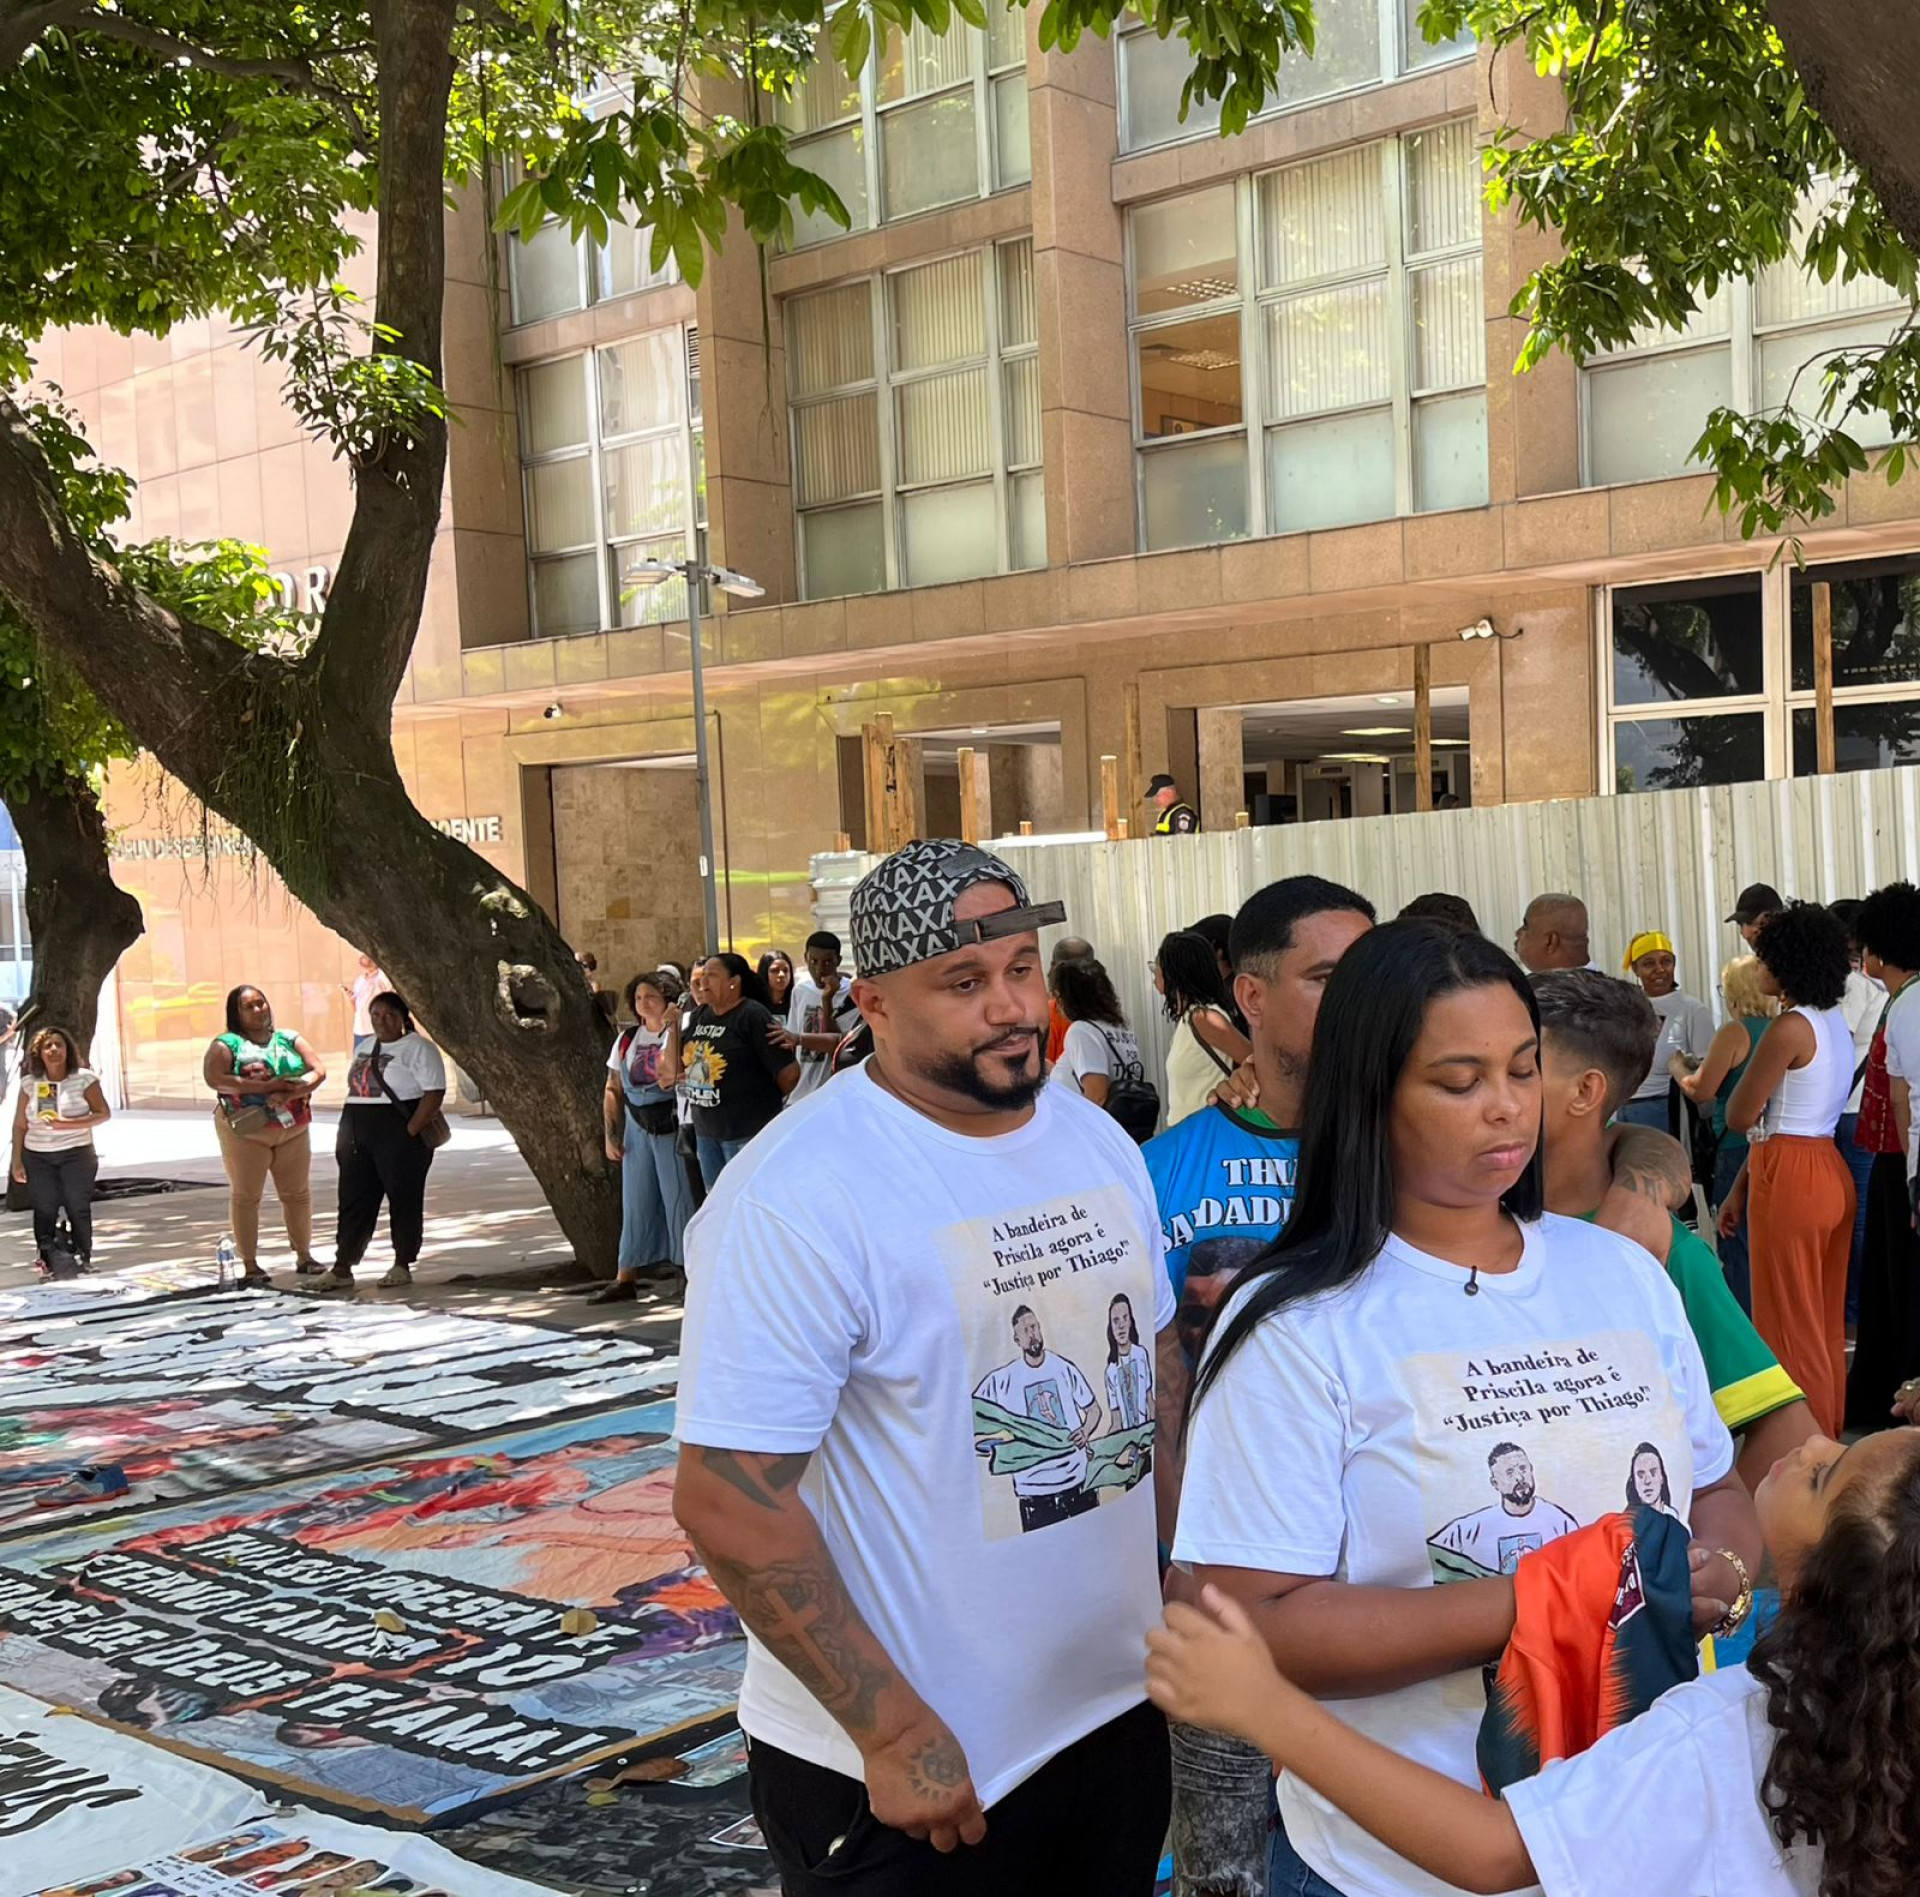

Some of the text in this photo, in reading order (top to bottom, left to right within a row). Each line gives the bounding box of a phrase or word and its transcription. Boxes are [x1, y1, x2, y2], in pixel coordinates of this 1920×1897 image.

[992, 1204, 1088, 1242] A bandeira de
[992, 1222, 1106, 1268] Priscila agora é
[1037, 1265, 1062, 1288] por
[1466, 1347, 1600, 1377] A bandeira de
[1463, 1365, 1623, 1402] Priscila agora é
[1442, 1405, 1533, 1433] “Justiça
[1537, 1402, 1572, 1424] por
[181, 1533, 364, 1585] THIAGO
[62, 1554, 251, 1611] ETERNO
[434, 1641, 588, 1687] 10
[61, 1620, 171, 1653] DE
[130, 1638, 312, 1696] DEUS
[282, 1682, 404, 1718] TE
[367, 1704, 609, 1768] AMA!
